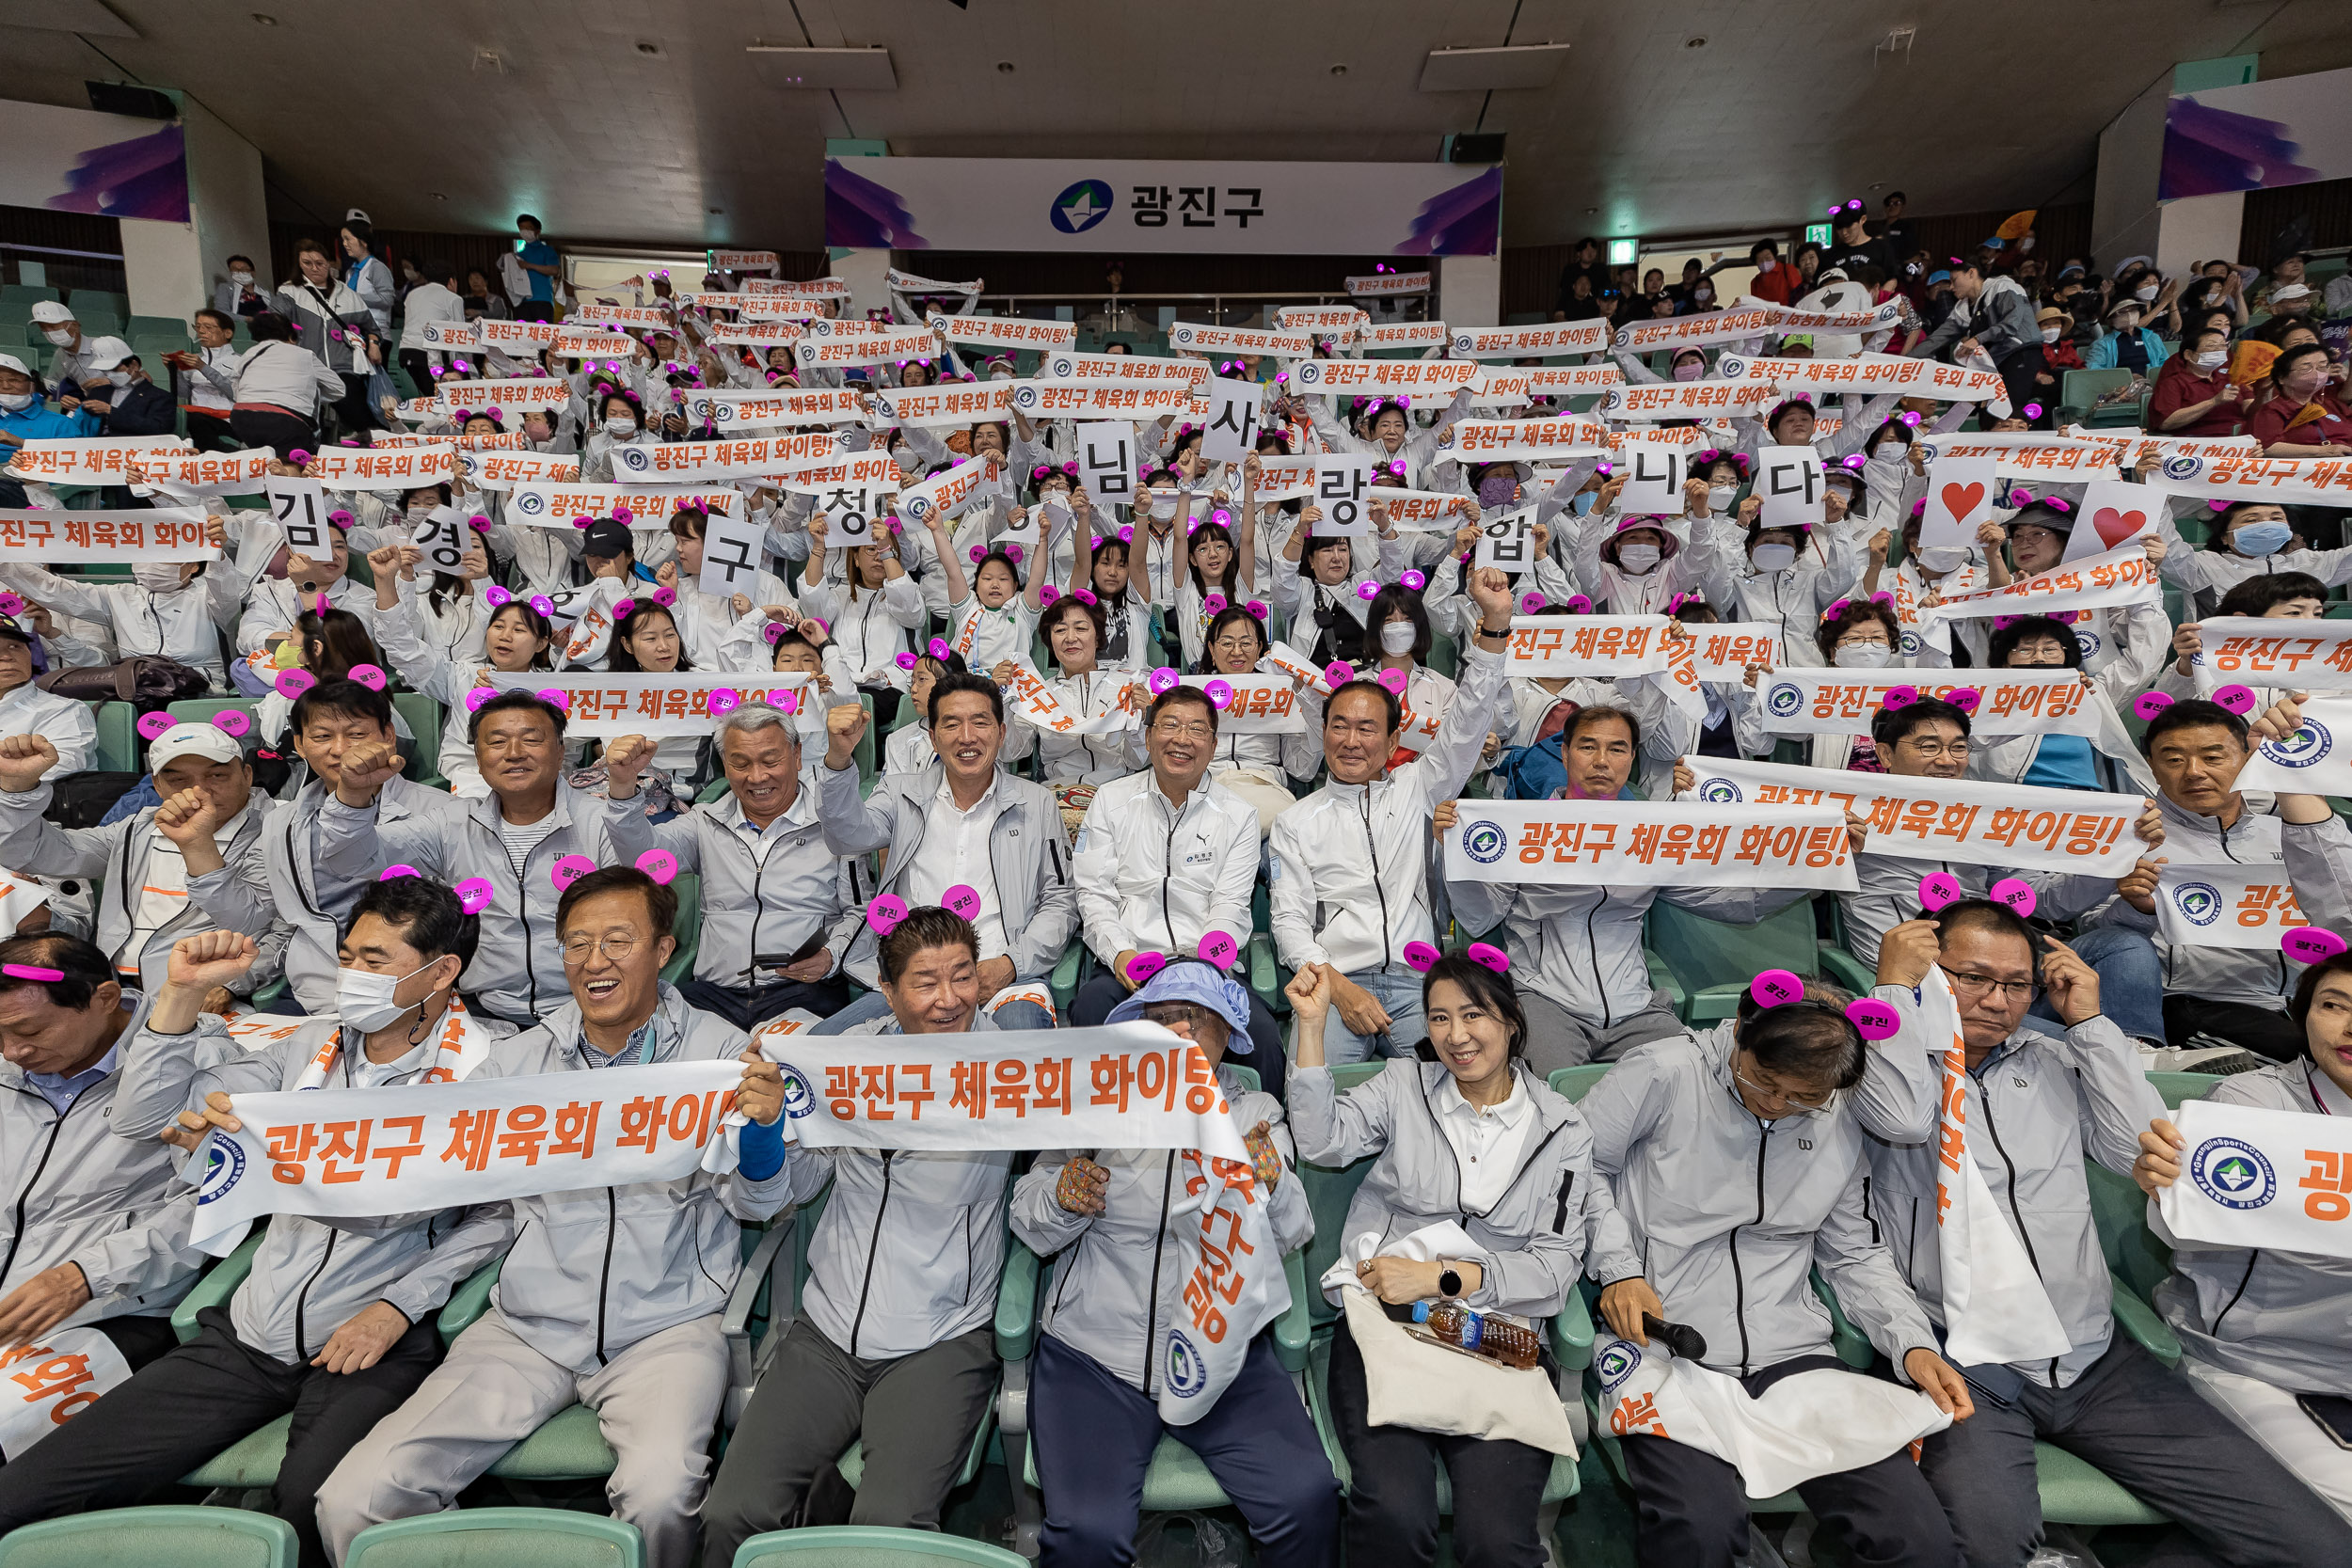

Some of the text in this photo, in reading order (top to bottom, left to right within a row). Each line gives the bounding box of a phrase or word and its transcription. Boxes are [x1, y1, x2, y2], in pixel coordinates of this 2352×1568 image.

[1132, 186, 1263, 228] 광진구
[583, 305, 669, 325] 광진구 체육회 화이
[771, 301, 801, 314] 체육회
[1284, 313, 1315, 327] 광진구
[1318, 312, 1348, 326] 체육회
[487, 324, 522, 341] 광진구
[834, 320, 866, 337] 광진구
[951, 319, 1069, 343] 광진구 체육회 화이팅!
[1197, 330, 1309, 351] 광진구 체육회 화이팅!
[1375, 328, 1406, 341] 체육회
[1408, 325, 1443, 339] 화이팅!
[1476, 327, 1600, 352] 광진구 체육회 화이팅!
[1634, 325, 1673, 345] 광진구
[1676, 317, 1719, 339] 체육회
[586, 338, 628, 354] 화이팅!
[820, 337, 933, 361] 광진구 체육회 화이팅!
[1076, 360, 1117, 378] 광진구
[1120, 361, 1161, 378] 체육회
[1325, 362, 1478, 385] 광진구 체육회 화이팅!
[1531, 369, 1622, 386] 체육회 화이팅!
[1749, 361, 1924, 382] 광진구 체육회 화이팅!
[450, 388, 485, 405] 광진구
[490, 386, 528, 404] 체육회
[738, 399, 785, 420] 광진구
[788, 393, 833, 415] 체육회
[898, 396, 939, 420] 광진구
[945, 391, 989, 414] 체육회
[1041, 387, 1089, 409] 광진구
[1091, 388, 1140, 408] 체육회
[1627, 387, 1730, 410] 광진구 체육회
[1211, 401, 1256, 447] 사
[1462, 425, 1516, 451] 광진구
[1520, 422, 1576, 447] 체육회
[654, 436, 833, 471] 광진구 체육회 화이팅!
[2012, 447, 2082, 469] 체육회
[179, 459, 241, 484] 체육회
[354, 454, 414, 479] 체육회
[484, 457, 542, 482] 광진구
[1088, 440, 1128, 493] 님
[1636, 453, 1676, 494] 니
[2208, 457, 2300, 486] 광진구
[935, 471, 978, 511] 광진구
[1771, 461, 1820, 504] 다
[551, 494, 605, 517] 광진구
[1321, 469, 1367, 525] 랑
[275, 493, 319, 546] 김
[825, 488, 866, 535] 청
[1389, 499, 1442, 522] 체육회
[64, 521, 144, 548] 체육회
[153, 519, 223, 548] 화이
[415, 519, 461, 567] 경
[1485, 515, 1532, 561] 합
[708, 537, 755, 582] 구
[2089, 559, 2147, 587] 화이
[1515, 626, 1652, 660] 진구 체육회
[2215, 637, 2324, 672] 광진구
[716, 697, 731, 709] 광진
[775, 696, 790, 705] 광진
[1224, 688, 1295, 718] 체육회
[1989, 684, 2085, 718] 화이팅!
[2222, 692, 2245, 705] 광진
[147, 719, 167, 729] 광진
[1863, 796, 2126, 855] 체육회 화이팅!
[1518, 822, 1850, 867] 광진구 체육회 화이팅!
[562, 866, 584, 879] 광진
[462, 888, 482, 899] 광진
[952, 895, 973, 911] 광진
[1931, 883, 1950, 899] 광진
[2006, 891, 2027, 905] 광진
[878, 906, 898, 919] 광진
[1209, 941, 1229, 958] 광진
[1765, 982, 1789, 1000] 광진
[1860, 1016, 1888, 1027] 광진
[825, 1064, 934, 1121] 광진구
[949, 1057, 1072, 1119] 체육회
[265, 1116, 425, 1185] 광진구
[439, 1101, 602, 1171] 체육회
